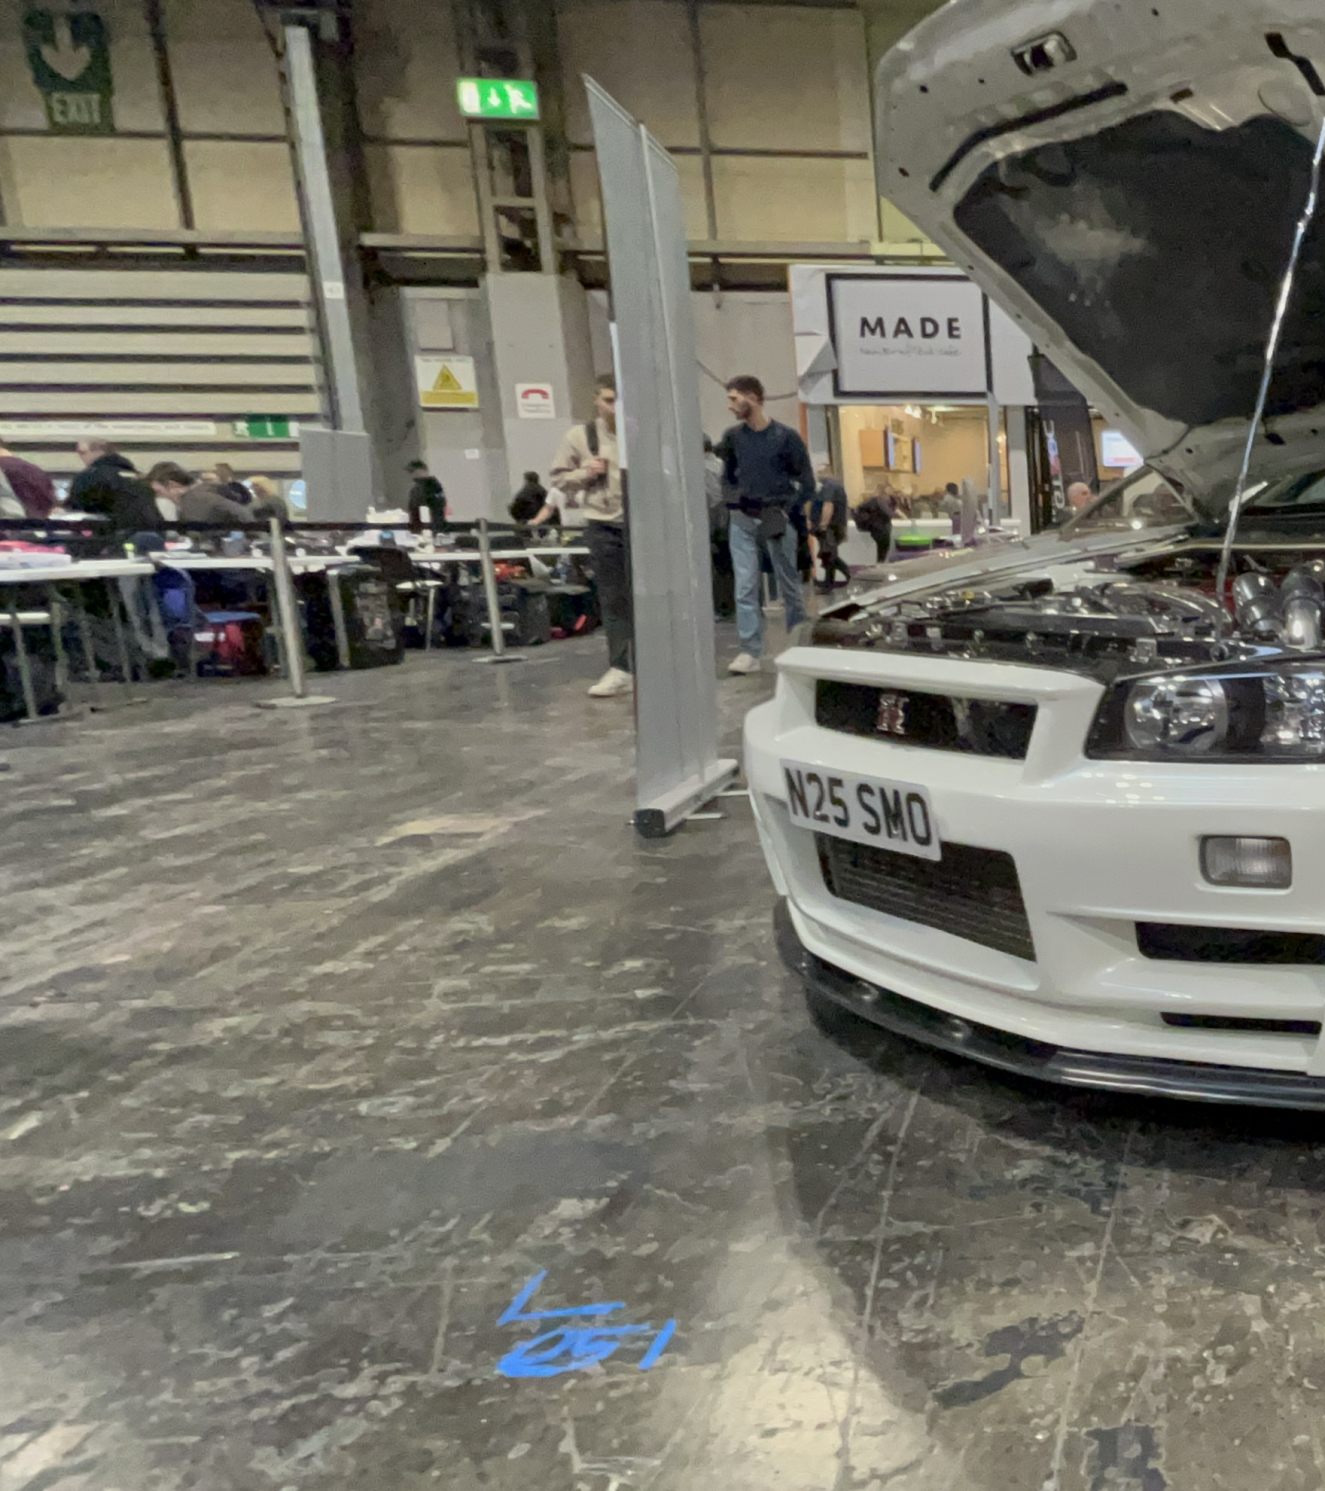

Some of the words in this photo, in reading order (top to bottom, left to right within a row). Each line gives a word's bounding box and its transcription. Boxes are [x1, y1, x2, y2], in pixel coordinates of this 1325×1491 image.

[51, 92, 101, 123] EXIT
[860, 316, 961, 339] MADE
[784, 768, 849, 828] N25
[856, 783, 932, 846] SMO
